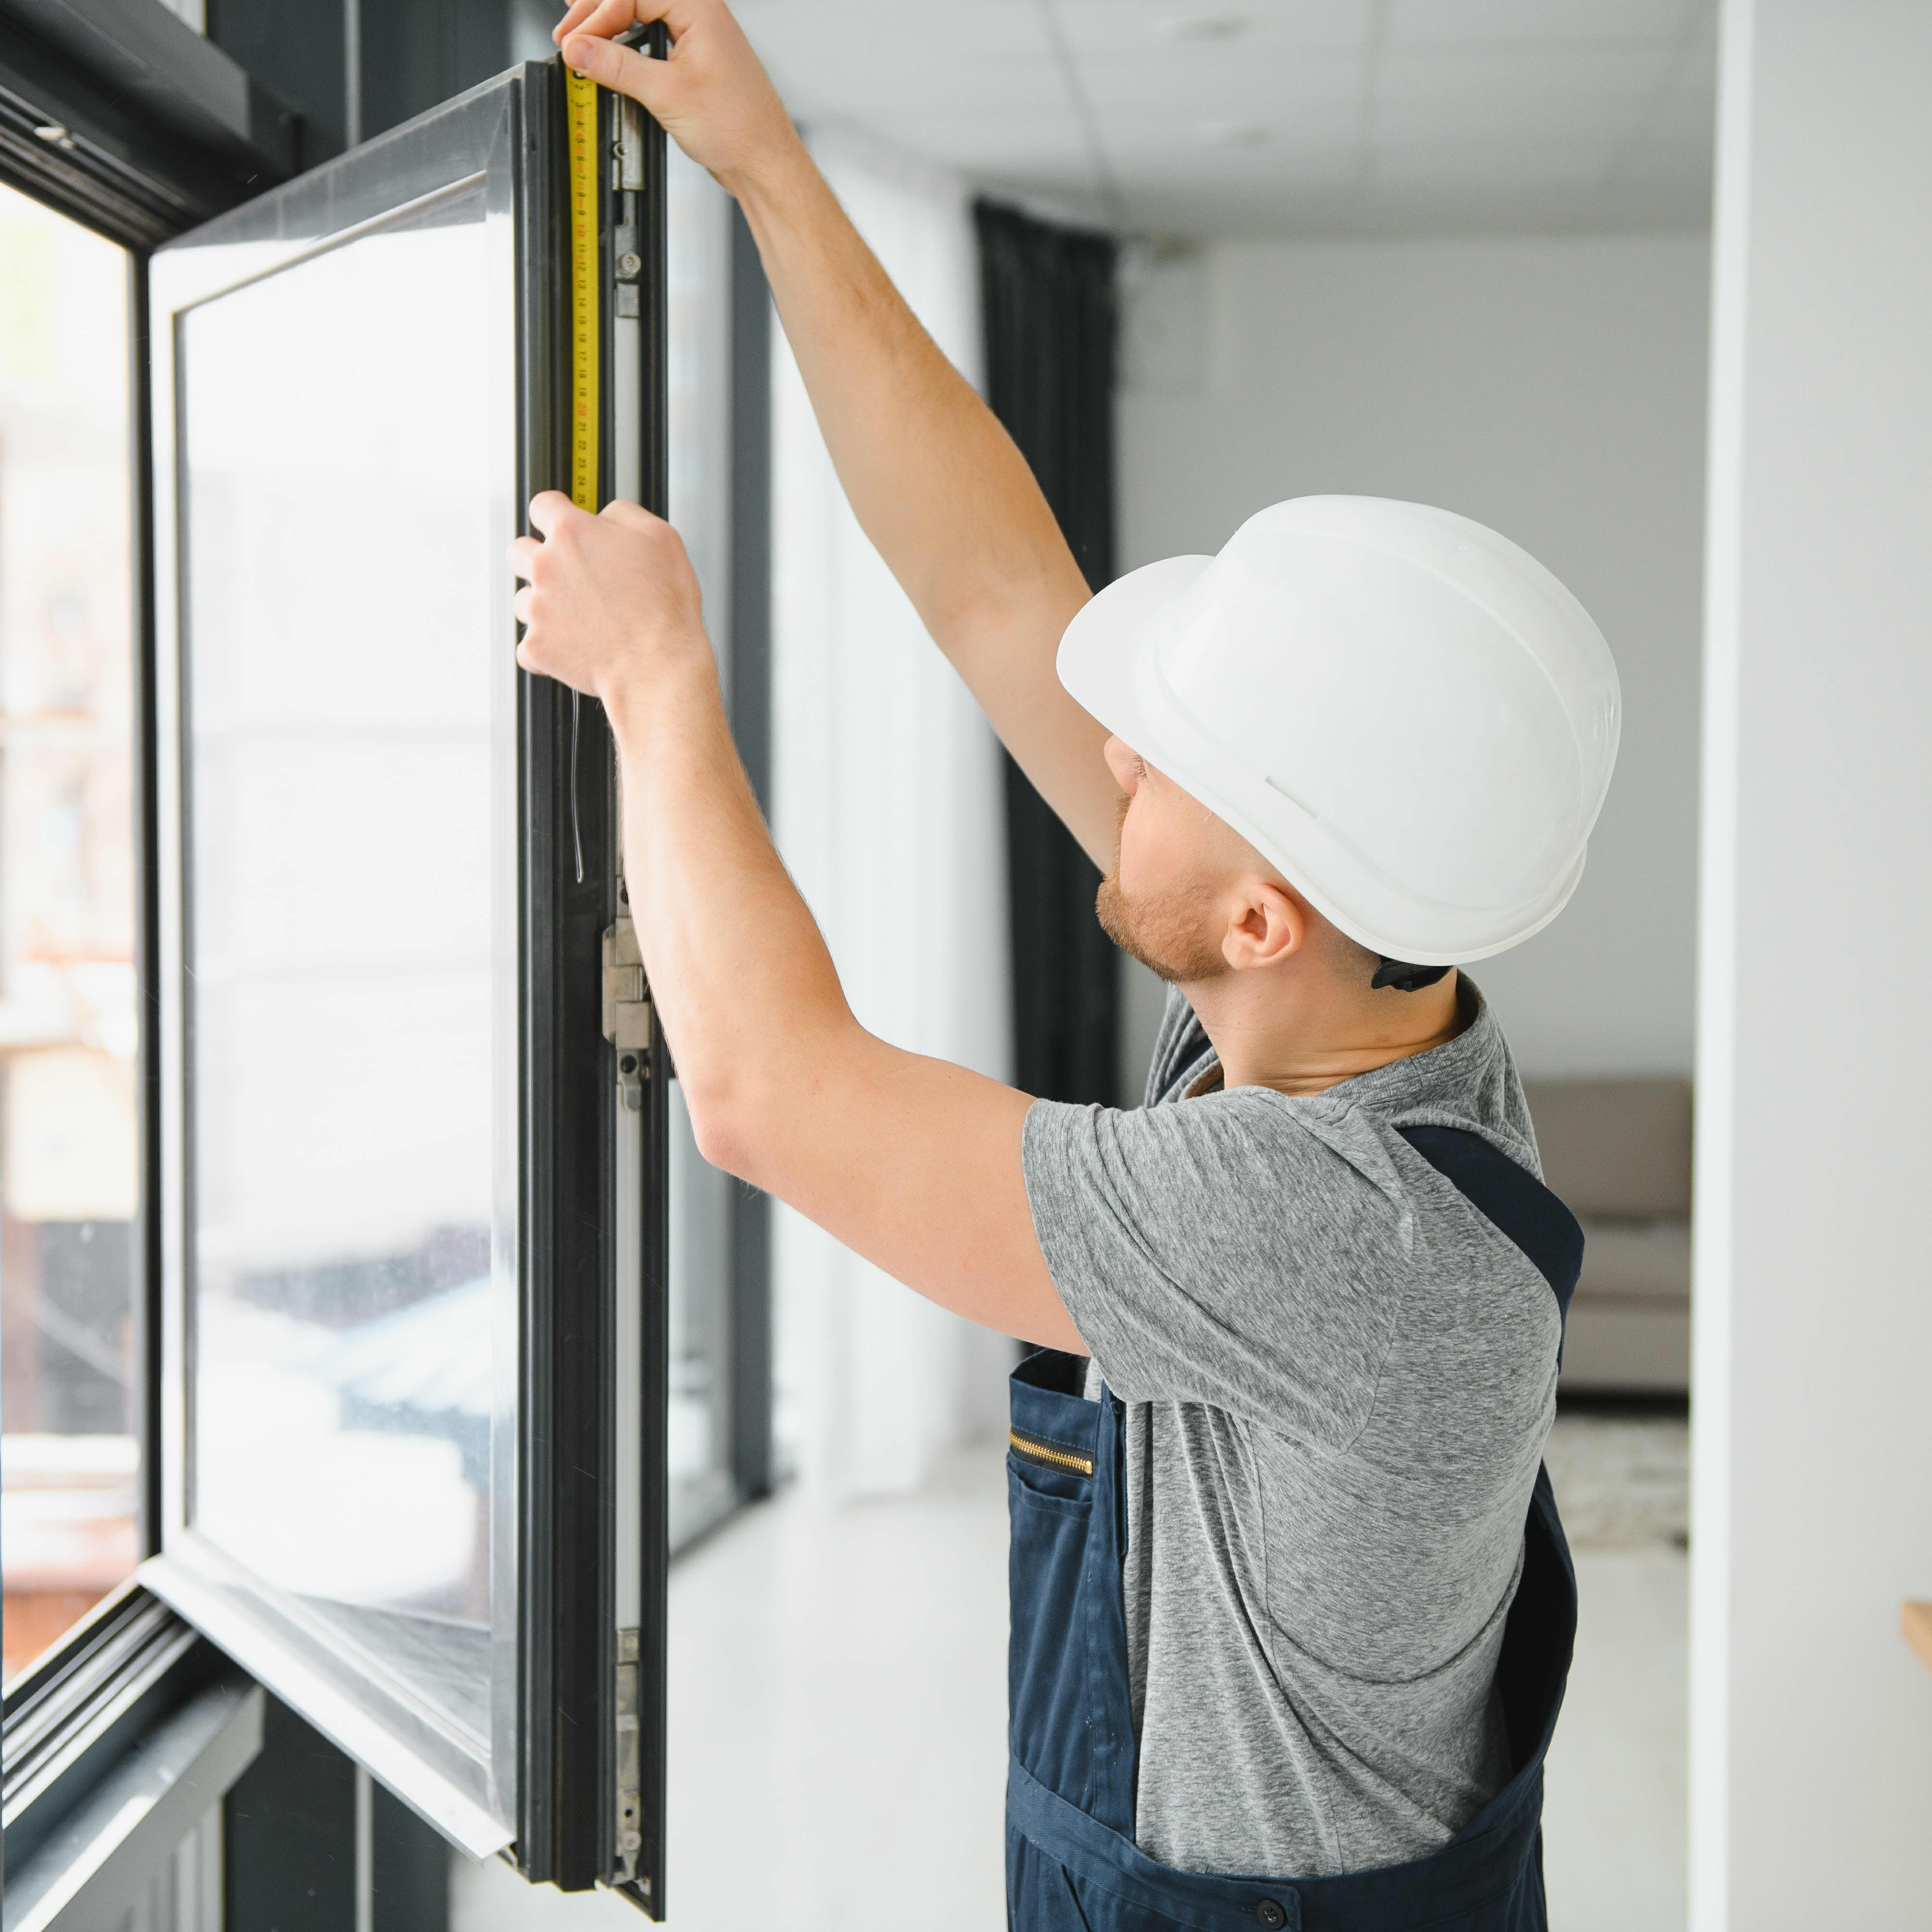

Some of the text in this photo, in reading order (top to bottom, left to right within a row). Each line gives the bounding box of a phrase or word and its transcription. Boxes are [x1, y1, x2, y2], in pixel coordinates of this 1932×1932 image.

[578, 224, 586, 237] 10
[578, 243, 585, 252] 11
[578, 262, 586, 271] 12
[579, 280, 586, 289] 13
[579, 298, 586, 306] 14
[579, 315, 586, 325] 15
[579, 334, 586, 342] 16
[579, 351, 587, 361] 17
[579, 369, 586, 378] 18
[579, 387, 587, 396] 19
[578, 402, 587, 416] 20
[579, 422, 586, 431] 21
[579, 440, 586, 450] 22
[579, 458, 586, 468] 23
[578, 476, 585, 485] 24
[577, 494, 585, 504] 25
